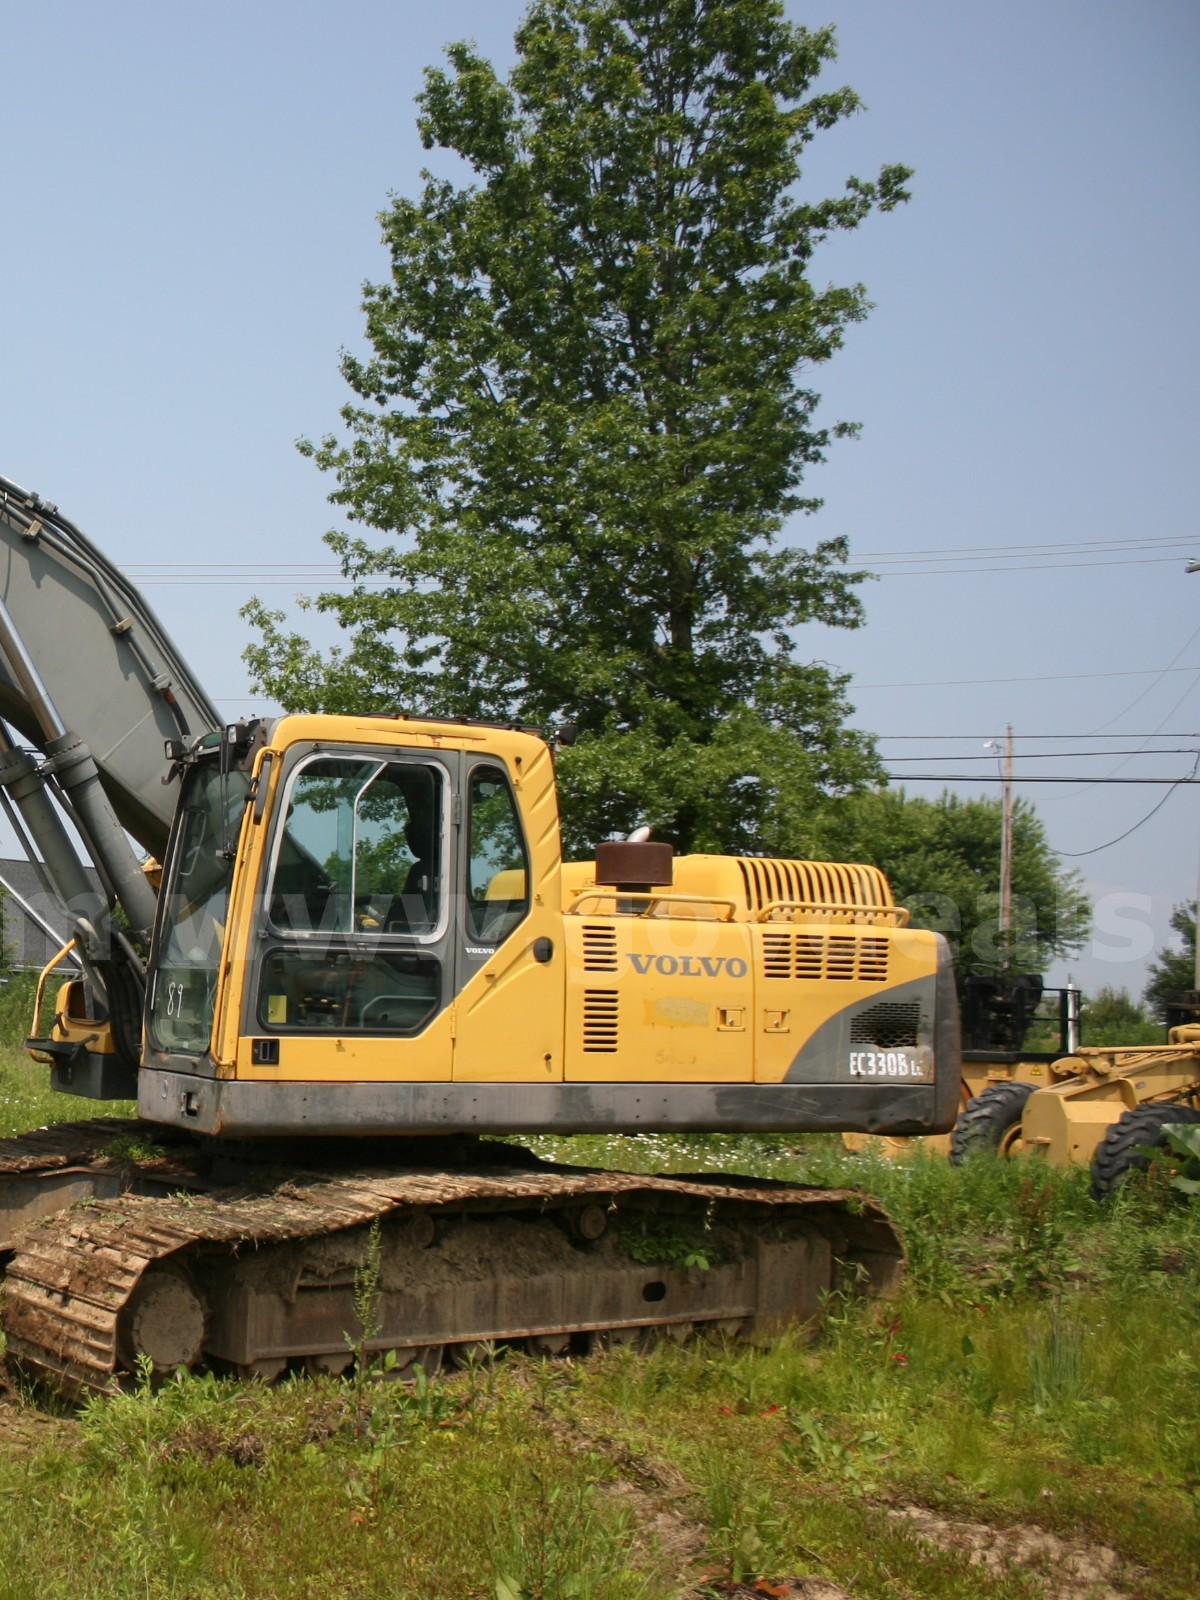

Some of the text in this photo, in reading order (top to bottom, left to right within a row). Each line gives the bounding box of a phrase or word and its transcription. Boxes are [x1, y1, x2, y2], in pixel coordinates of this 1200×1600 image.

[465, 946, 495, 954] VOLVO
[626, 953, 748, 978] VOLVO
[167, 982, 183, 1018] 89
[849, 1052, 908, 1076] EC330B
